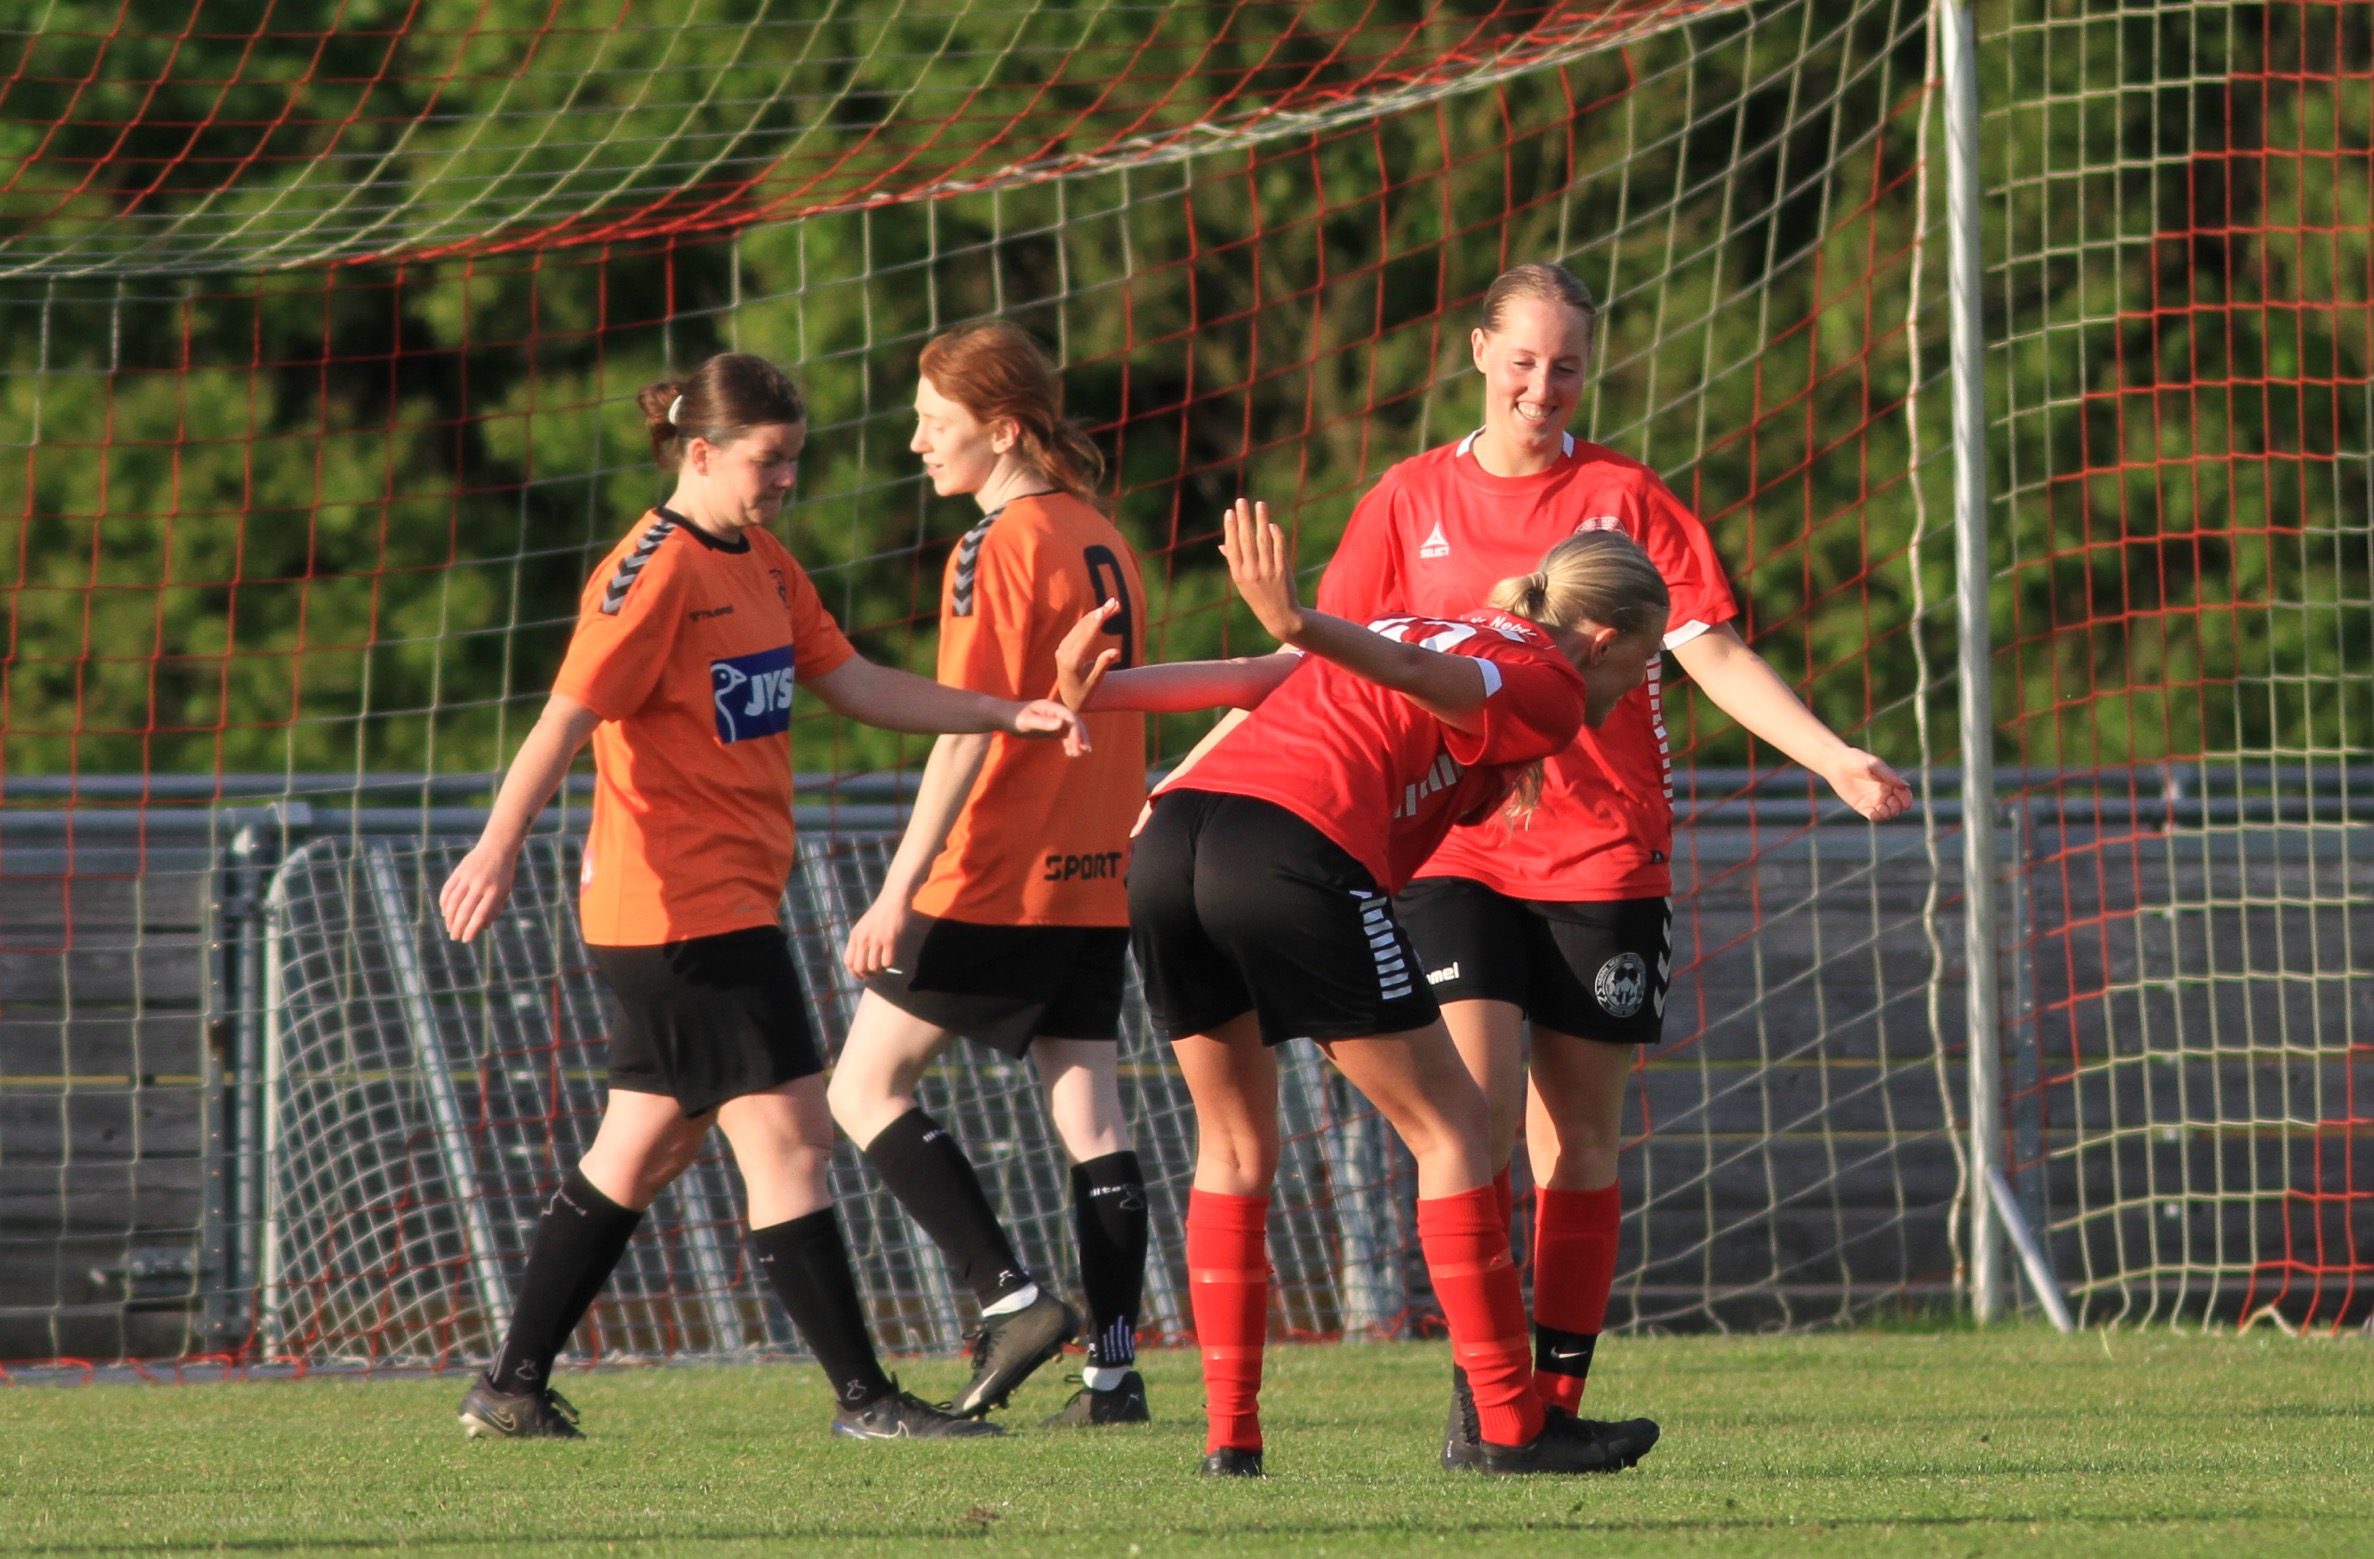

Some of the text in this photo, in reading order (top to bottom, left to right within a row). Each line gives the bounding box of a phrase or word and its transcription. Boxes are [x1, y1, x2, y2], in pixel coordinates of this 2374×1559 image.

[1420, 546, 1450, 559] SELECT
[744, 665, 795, 717] JYS
[1044, 852, 1123, 881] SPORT
[1426, 961, 1460, 985] mel
